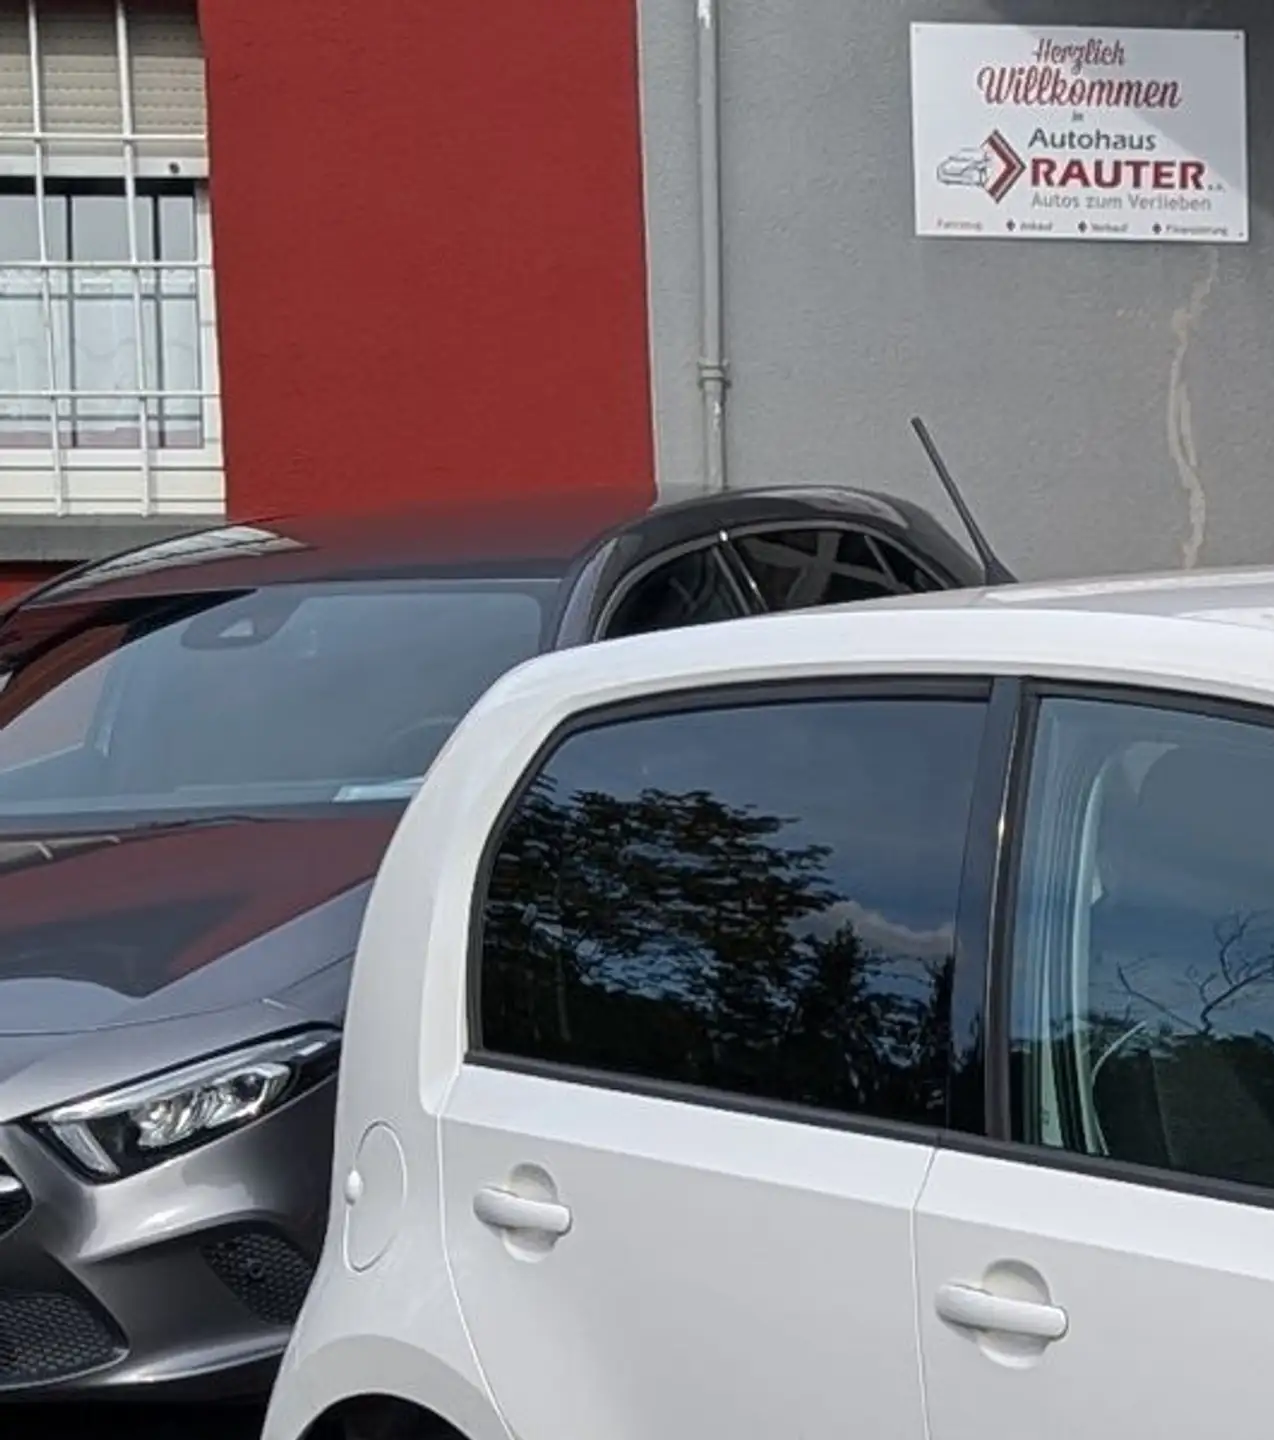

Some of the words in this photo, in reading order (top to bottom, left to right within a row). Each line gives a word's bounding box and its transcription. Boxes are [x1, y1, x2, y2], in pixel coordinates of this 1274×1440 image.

[1034, 37, 1126, 75] Herzlich
[976, 65, 1184, 110] Willkommen
[1028, 127, 1157, 152] Autohaus
[1030, 157, 1206, 191] RAUTER
[1031, 192, 1081, 210] Autos
[1085, 196, 1123, 210] zum
[1128, 193, 1212, 212] Verlieben
